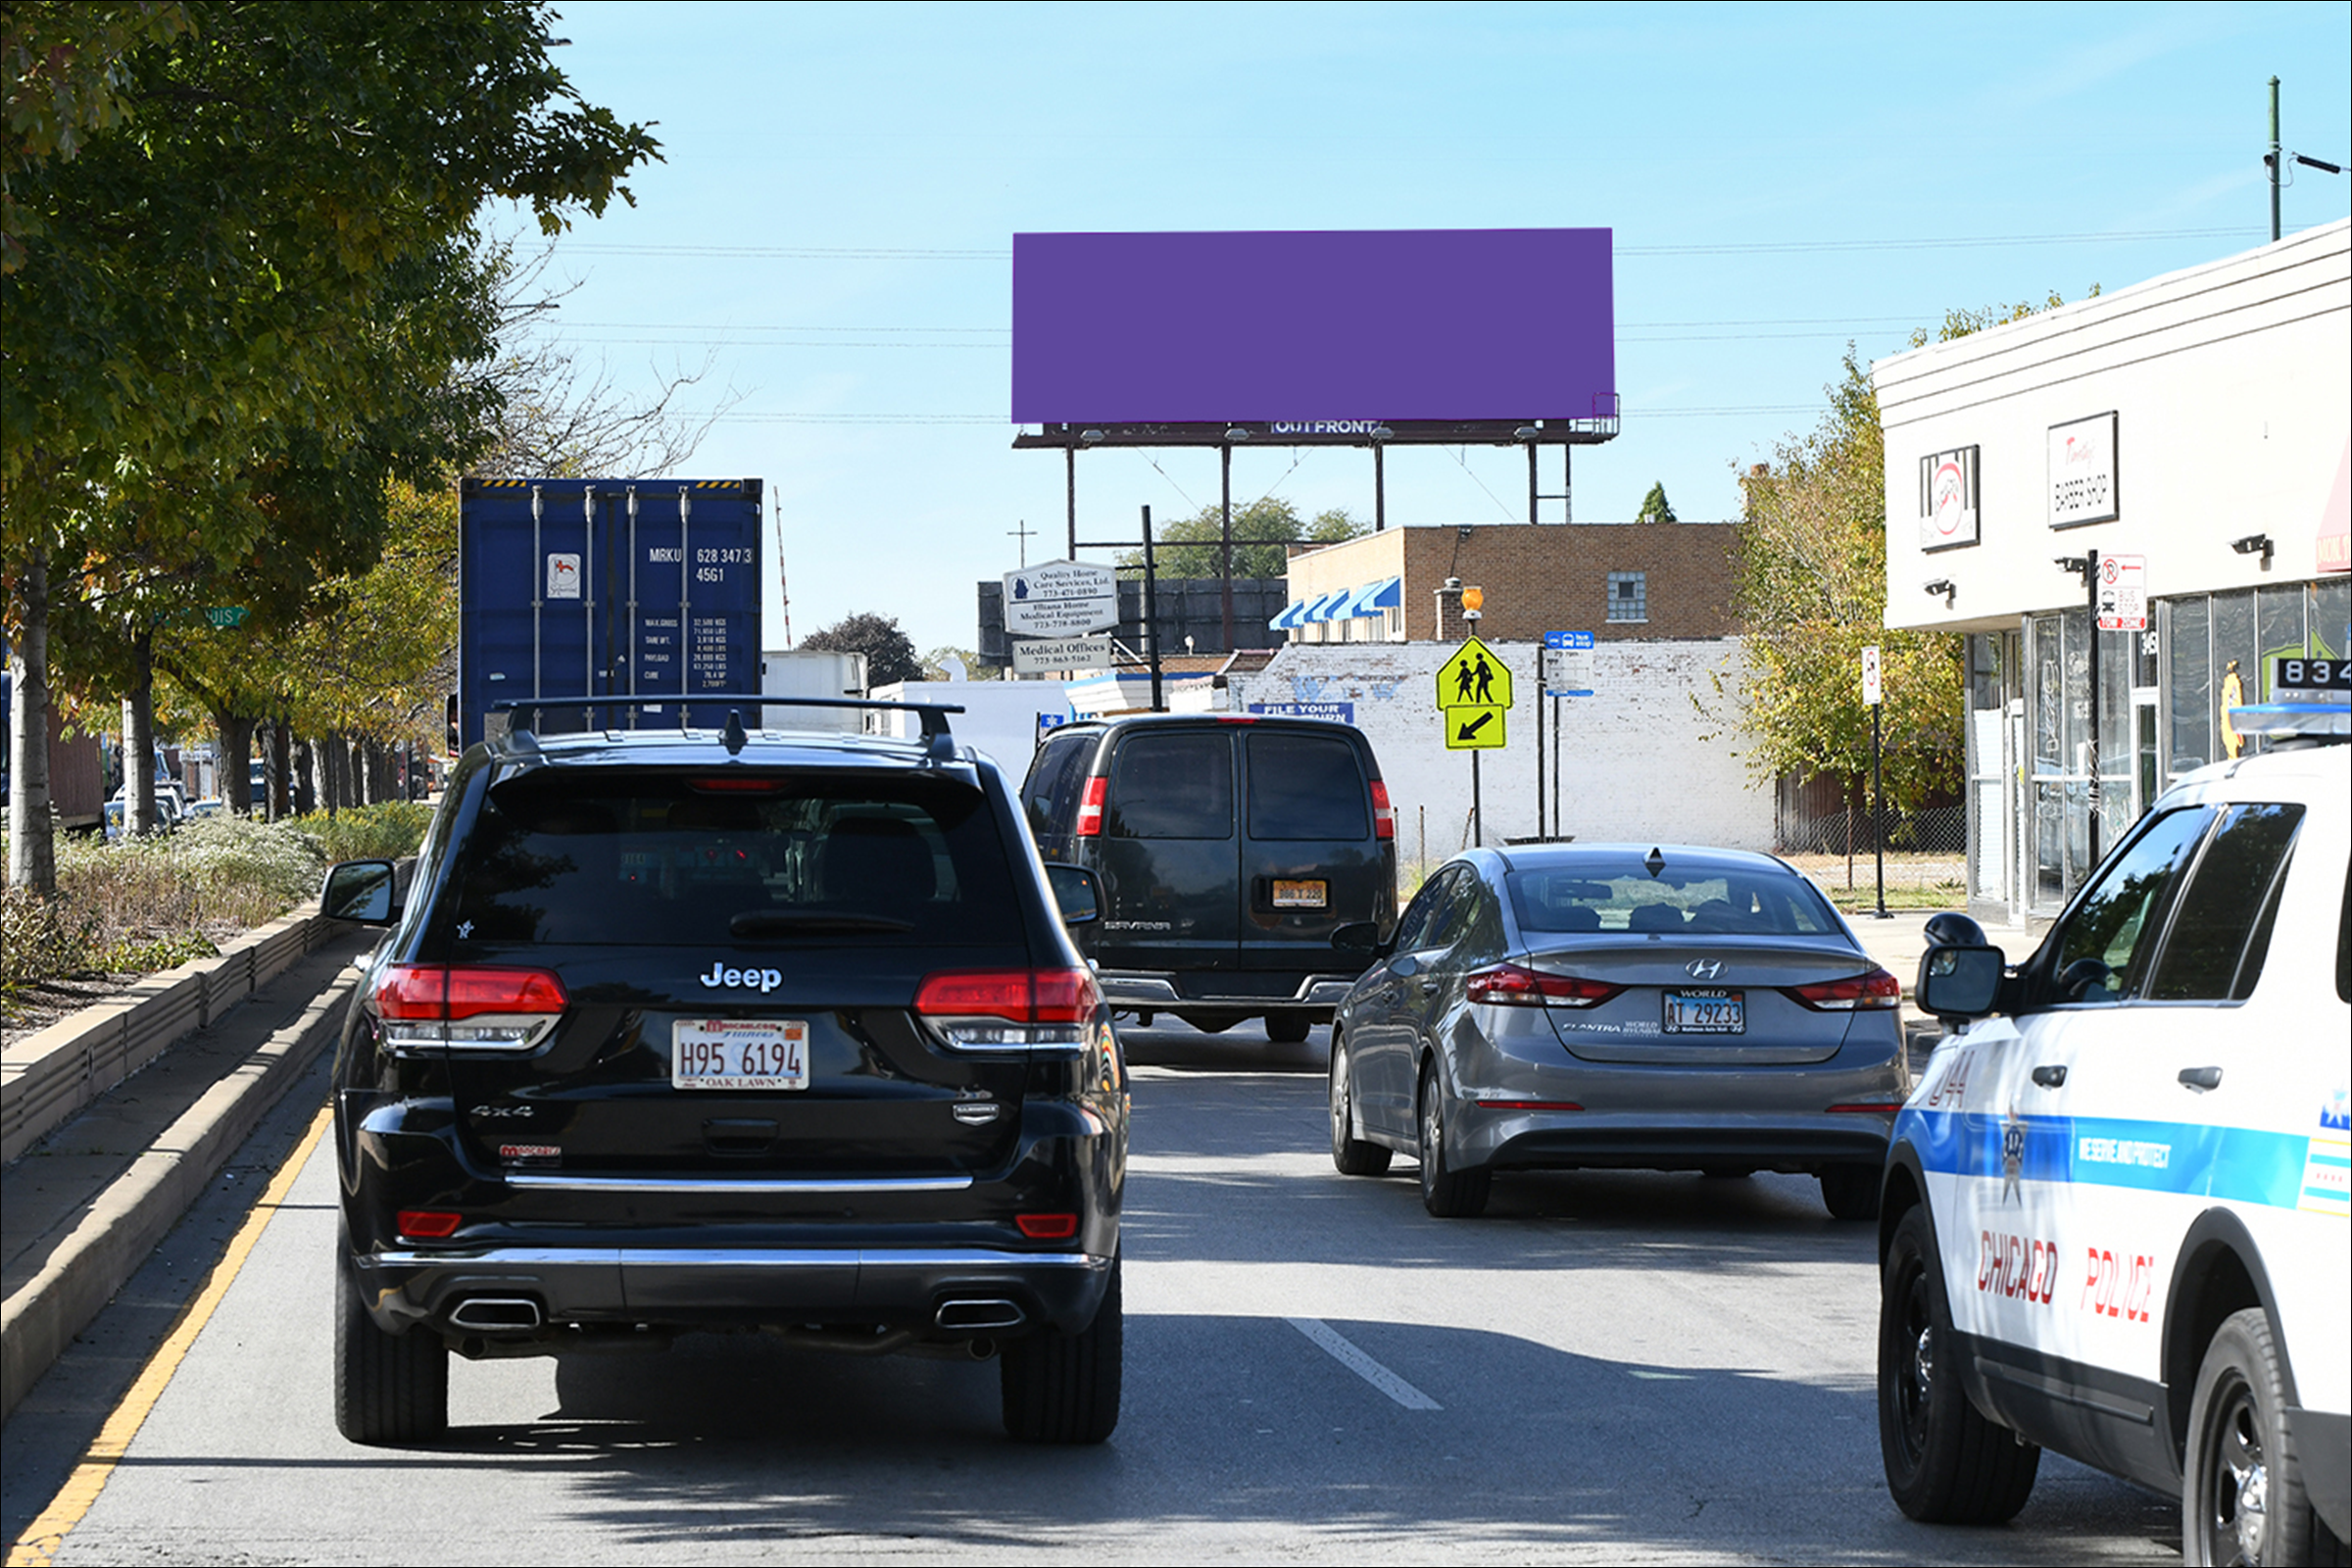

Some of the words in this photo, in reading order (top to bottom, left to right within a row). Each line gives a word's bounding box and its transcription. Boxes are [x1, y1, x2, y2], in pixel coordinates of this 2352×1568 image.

[650, 548, 682, 563] MRKU
[697, 548, 718, 564] 628
[720, 548, 742, 564] 347
[696, 567, 724, 582] 45G1
[1040, 570, 1070, 580] Quality
[1034, 580, 1054, 589] Care
[1055, 579, 1093, 588] Services,
[1094, 576, 1109, 585] Ltd.
[1020, 612, 1054, 620] Medical
[1056, 610, 1103, 618] Equipment
[1020, 644, 1063, 656] Medical
[1067, 642, 1105, 653] Offices
[1264, 705, 1296, 715] FILE
[1298, 704, 1339, 713] YOUR
[700, 961, 782, 993] Jeep
[1667, 1003, 1684, 1024] AT
[1694, 1003, 1741, 1024] 29233
[1562, 1022, 1621, 1033] ELANTRA
[681, 1042, 724, 1075] H95
[742, 1042, 801, 1075] 6194
[706, 1077, 735, 1088] OAK
[738, 1077, 776, 1088] LAWN
[470, 1104, 534, 1117] 4x4
[1979, 1230, 2058, 1305] CHICAGO
[2081, 1247, 2154, 1323] POLICE
